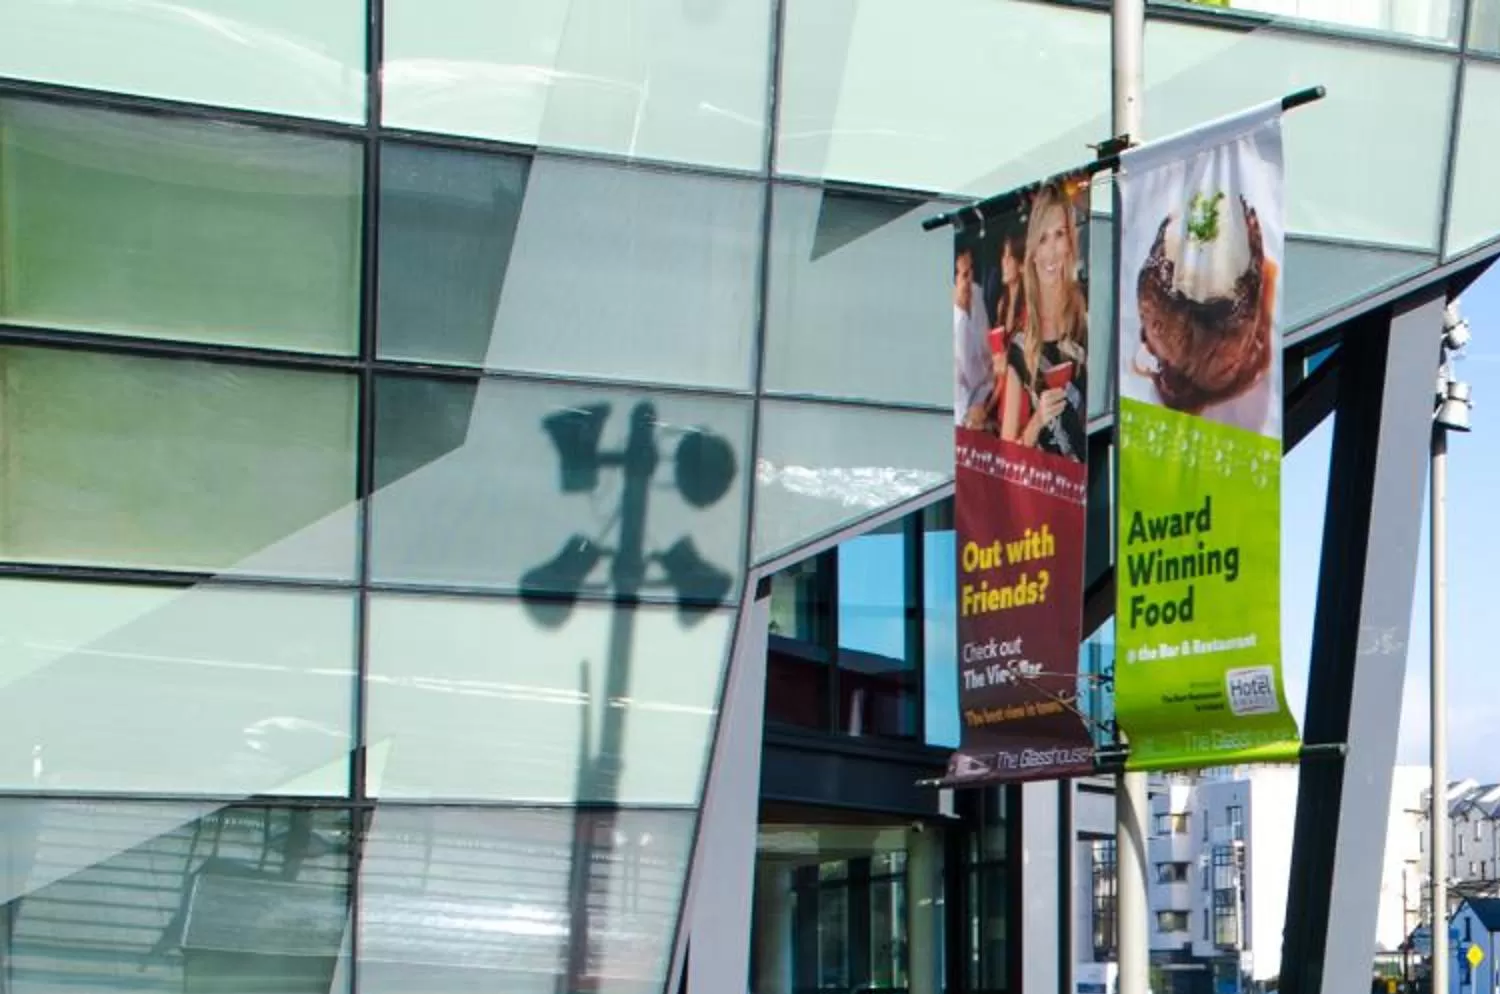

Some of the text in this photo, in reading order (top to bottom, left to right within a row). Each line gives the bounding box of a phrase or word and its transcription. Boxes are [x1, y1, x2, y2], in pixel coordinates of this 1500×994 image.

[1127, 495, 1212, 546] Award
[963, 523, 1055, 573] Out with
[1127, 541, 1240, 587] Winning
[962, 569, 1050, 617] Friends?
[1130, 584, 1194, 629] Food
[963, 635, 1023, 663] Check out
[963, 668, 986, 690] The
[986, 661, 1018, 685] Vie
[1230, 675, 1272, 697] Hotel
[998, 747, 1089, 768] The Glasshouse
